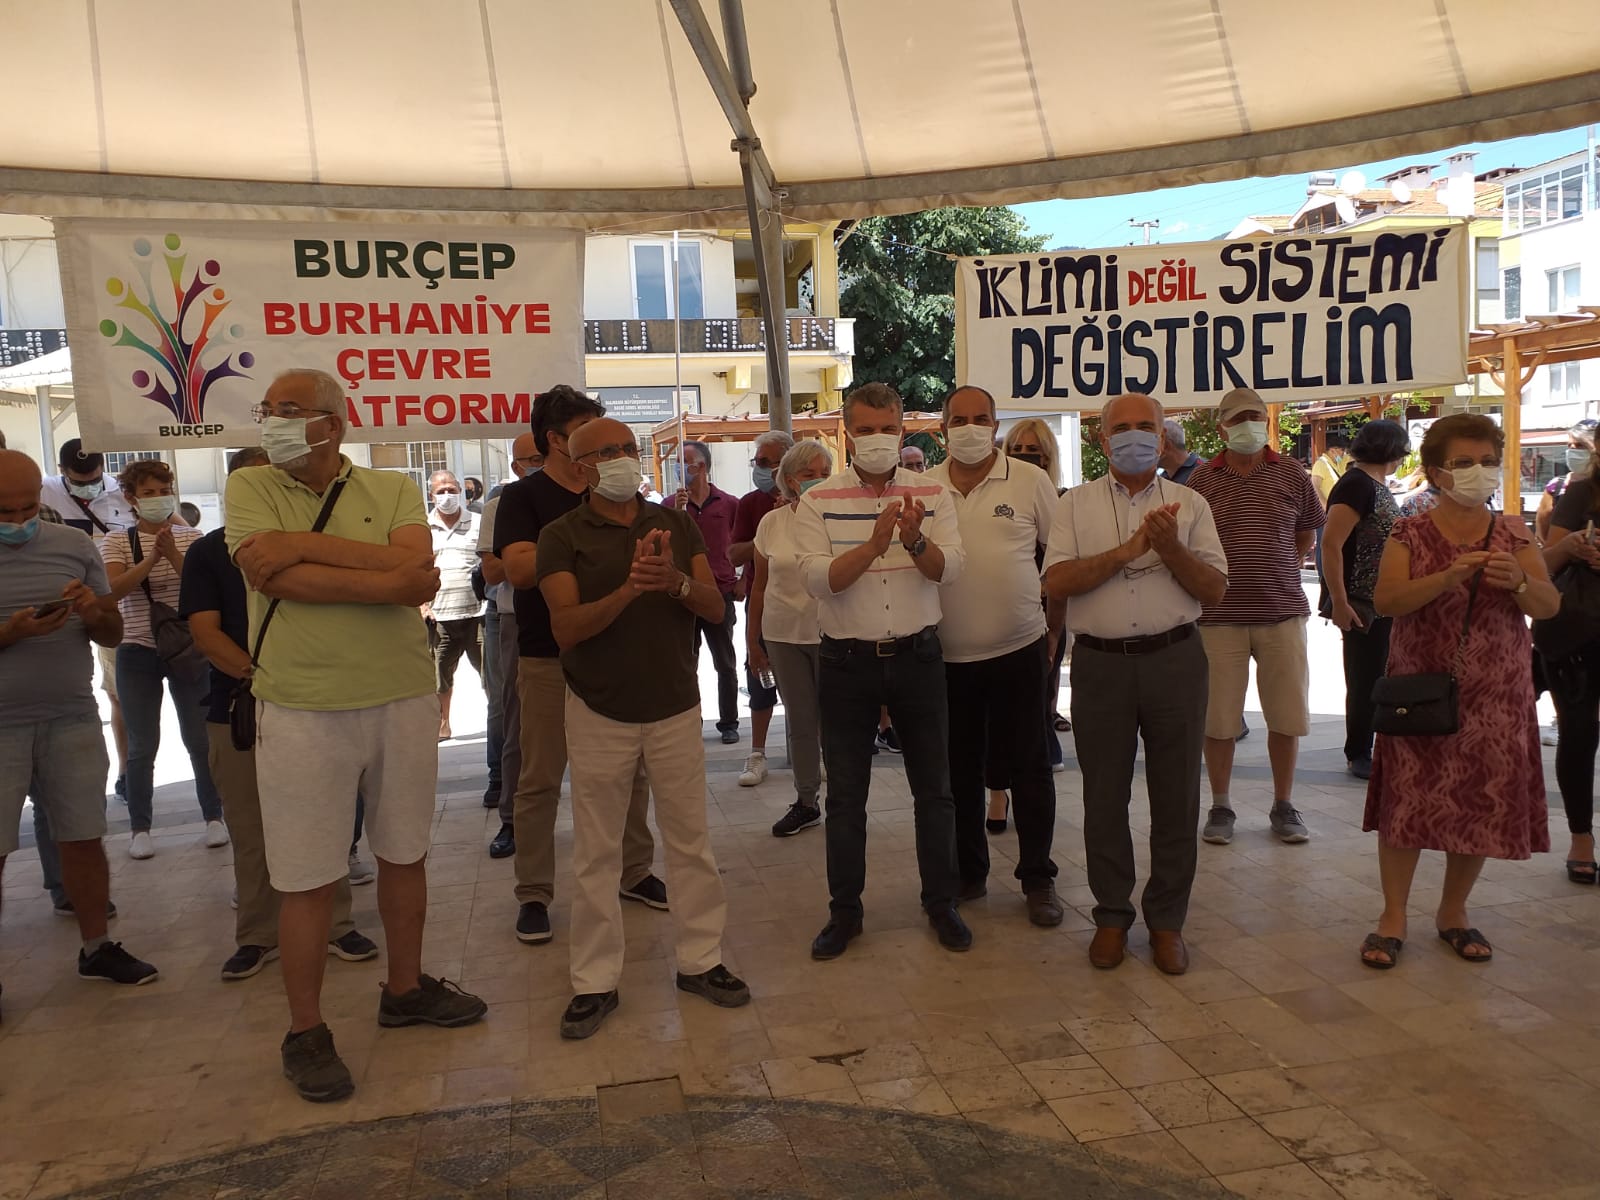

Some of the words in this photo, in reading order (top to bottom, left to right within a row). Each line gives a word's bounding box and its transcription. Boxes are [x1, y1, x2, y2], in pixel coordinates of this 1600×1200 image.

[294, 239, 516, 289] BURÇEP
[1128, 258, 1207, 306] DEĞİL
[1219, 228, 1452, 304] SİSTEMİ
[263, 295, 551, 335] BURHANİYE
[584, 321, 648, 352] LU
[705, 318, 834, 350] OLUN
[336, 348, 491, 389] ÇEVRE
[345, 393, 546, 427] ATFORM
[159, 424, 224, 438] BURÇEP
